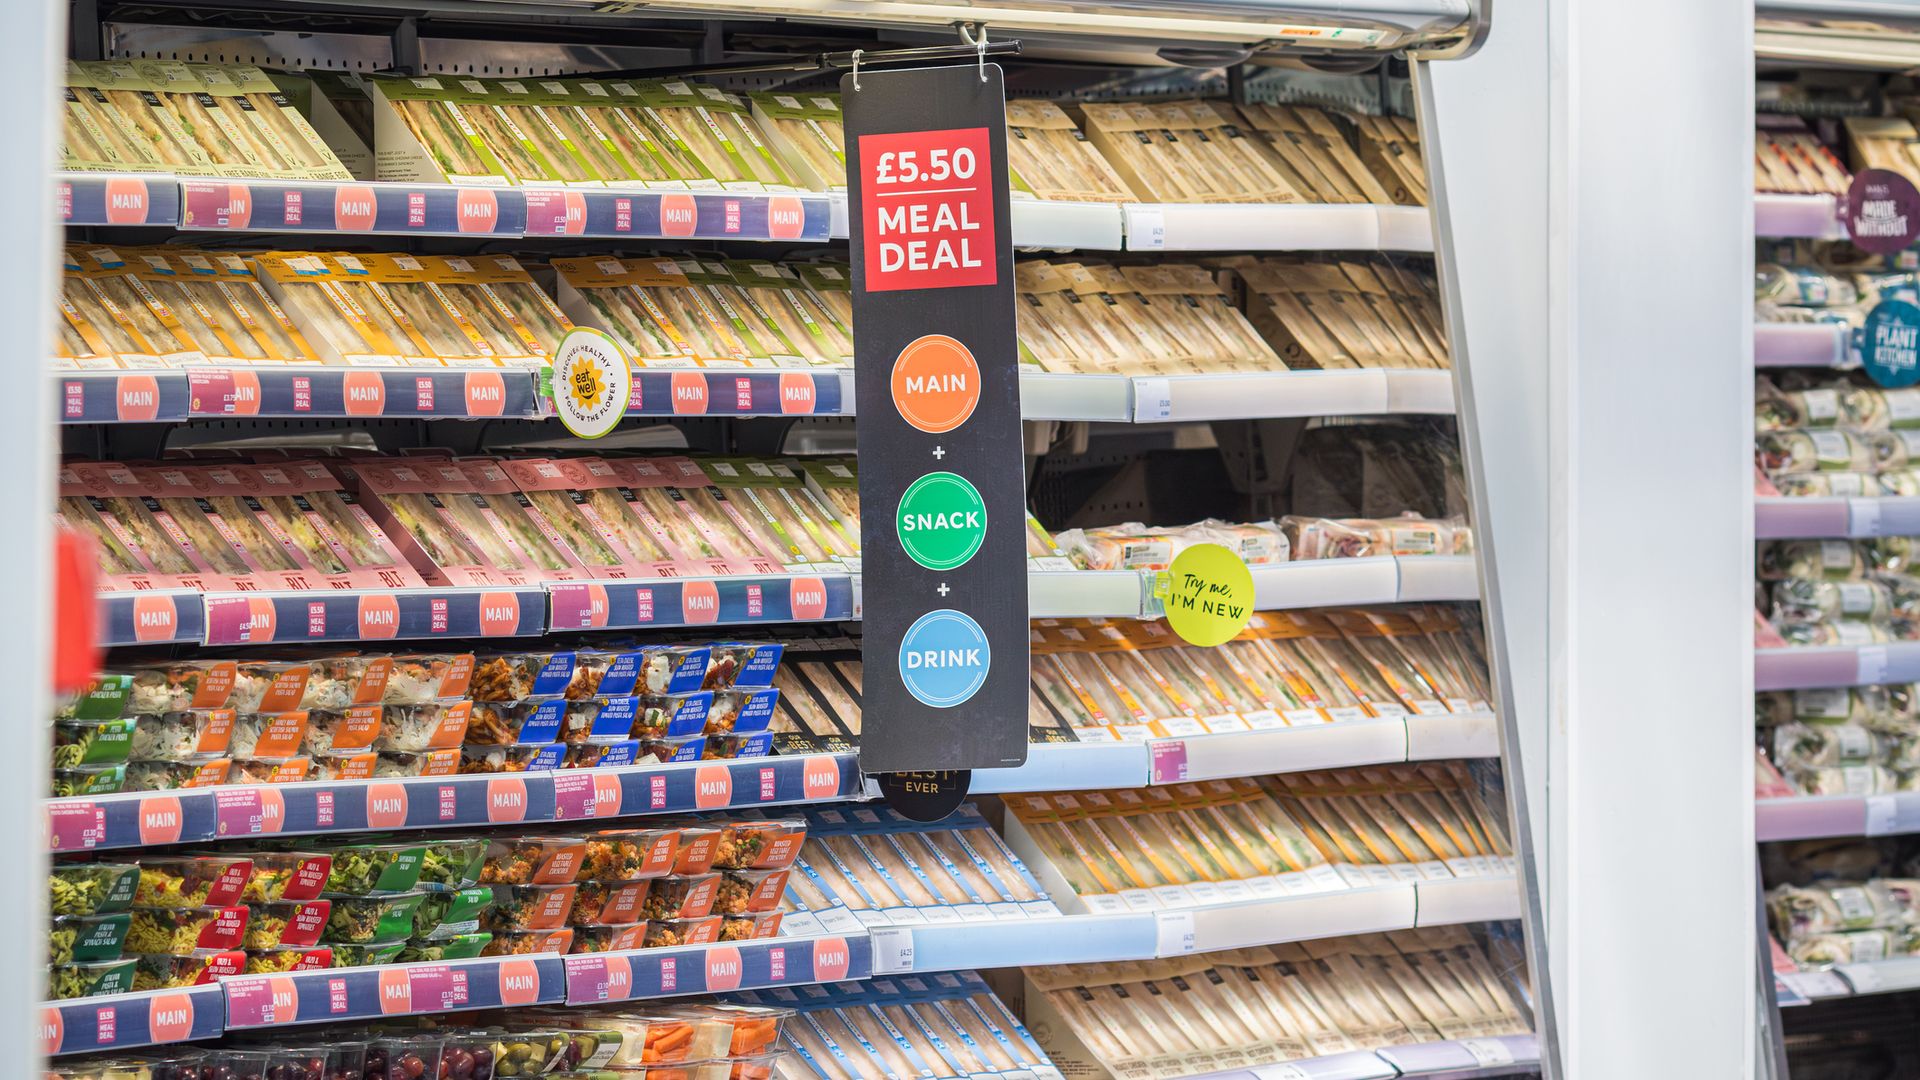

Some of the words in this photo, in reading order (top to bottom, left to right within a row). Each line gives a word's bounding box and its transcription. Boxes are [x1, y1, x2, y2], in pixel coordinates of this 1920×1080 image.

[876, 147, 976, 184] £5.50
[112, 194, 142, 209] MAIN
[229, 200, 245, 214] AIN
[286, 206, 300, 214] MEAL
[341, 202, 370, 216] MAIN
[410, 207, 424, 215] MEAL
[464, 204, 492, 217] MAIN
[566, 207, 581, 221] AIN
[666, 208, 692, 223] MAIN
[286, 213, 300, 221] DEAL
[410, 215, 424, 223] DEAL
[773, 210, 799, 225] MAIN
[878, 202, 980, 235] MEAL
[617, 221, 630, 229] DEAL
[727, 222, 739, 230] DEAL
[879, 238, 982, 272] DEAL
[562, 346, 580, 381] DISCOVER
[580, 345, 611, 368] HEALTHY
[575, 368, 590, 384] eat
[577, 377, 597, 395] well
[905, 373, 966, 394] MAIN
[123, 392, 152, 406] MAIN
[235, 387, 254, 401] AIN
[295, 392, 309, 400] MEAL
[350, 387, 379, 400] MAIN
[418, 392, 432, 400] MEAL
[471, 387, 499, 400] MAIN
[677, 386, 703, 401] MAIN
[738, 391, 750, 399] MEAL
[785, 387, 810, 400] MAIN
[68, 398, 82, 406] MEAL
[295, 400, 310, 408] DEAL
[565, 395, 585, 422] FOLLOW
[587, 413, 599, 422] THE
[600, 382, 616, 416] FLOWER
[68, 406, 82, 414] DEAL
[903, 511, 980, 532] SNACK
[1184, 573, 1207, 597] Try
[1209, 583, 1232, 598] me,
[688, 595, 713, 610] MAIN
[796, 591, 821, 606] MAIN
[639, 603, 652, 611] MEAL
[749, 606, 761, 614] DEAL
[1171, 593, 1195, 610] I'M
[1202, 600, 1244, 619] NEW
[141, 612, 171, 627] MAIN
[365, 610, 393, 625] MAIN
[486, 607, 513, 620] MAIN
[250, 614, 269, 629] AIN
[311, 617, 324, 625] MEAL
[433, 621, 446, 629] DEAL
[311, 625, 324, 633] DEAL
[907, 648, 981, 669] DRINK
[809, 772, 834, 787] MAIN
[701, 781, 726, 796] MAIN
[762, 790, 774, 798] DEAL
[905, 781, 939, 793] EVER
[493, 793, 521, 808] MAIN
[595, 789, 616, 804] AIN
[652, 798, 665, 806] DEAL
[262, 804, 278, 819] AIN
[319, 807, 332, 815] MEAL
[373, 798, 401, 814] MAIN
[441, 801, 454, 809] MEAL
[146, 812, 176, 828] MAIN
[319, 815, 333, 823] DEAL
[441, 809, 454, 817] DEAL
[819, 952, 844, 967] MAIN
[900, 949, 913, 958] £4.25
[662, 972, 675, 980] MEAL
[711, 961, 737, 977] MAIN
[772, 969, 785, 978] DEAL
[505, 976, 533, 991] MAIN
[609, 972, 626, 987] AIN
[662, 979, 675, 988] DEAL
[453, 985, 467, 993] MEAL
[272, 992, 291, 1007] AIN
[332, 994, 346, 1002] MEAL
[453, 992, 467, 1001] DEAL
[332, 1001, 346, 1009] DEAL
[156, 1009, 187, 1026] MAIN
[34, 1024, 56, 1040] AIN
[99, 1023, 114, 1032] MEAL
[99, 1031, 114, 1040] DEAL
